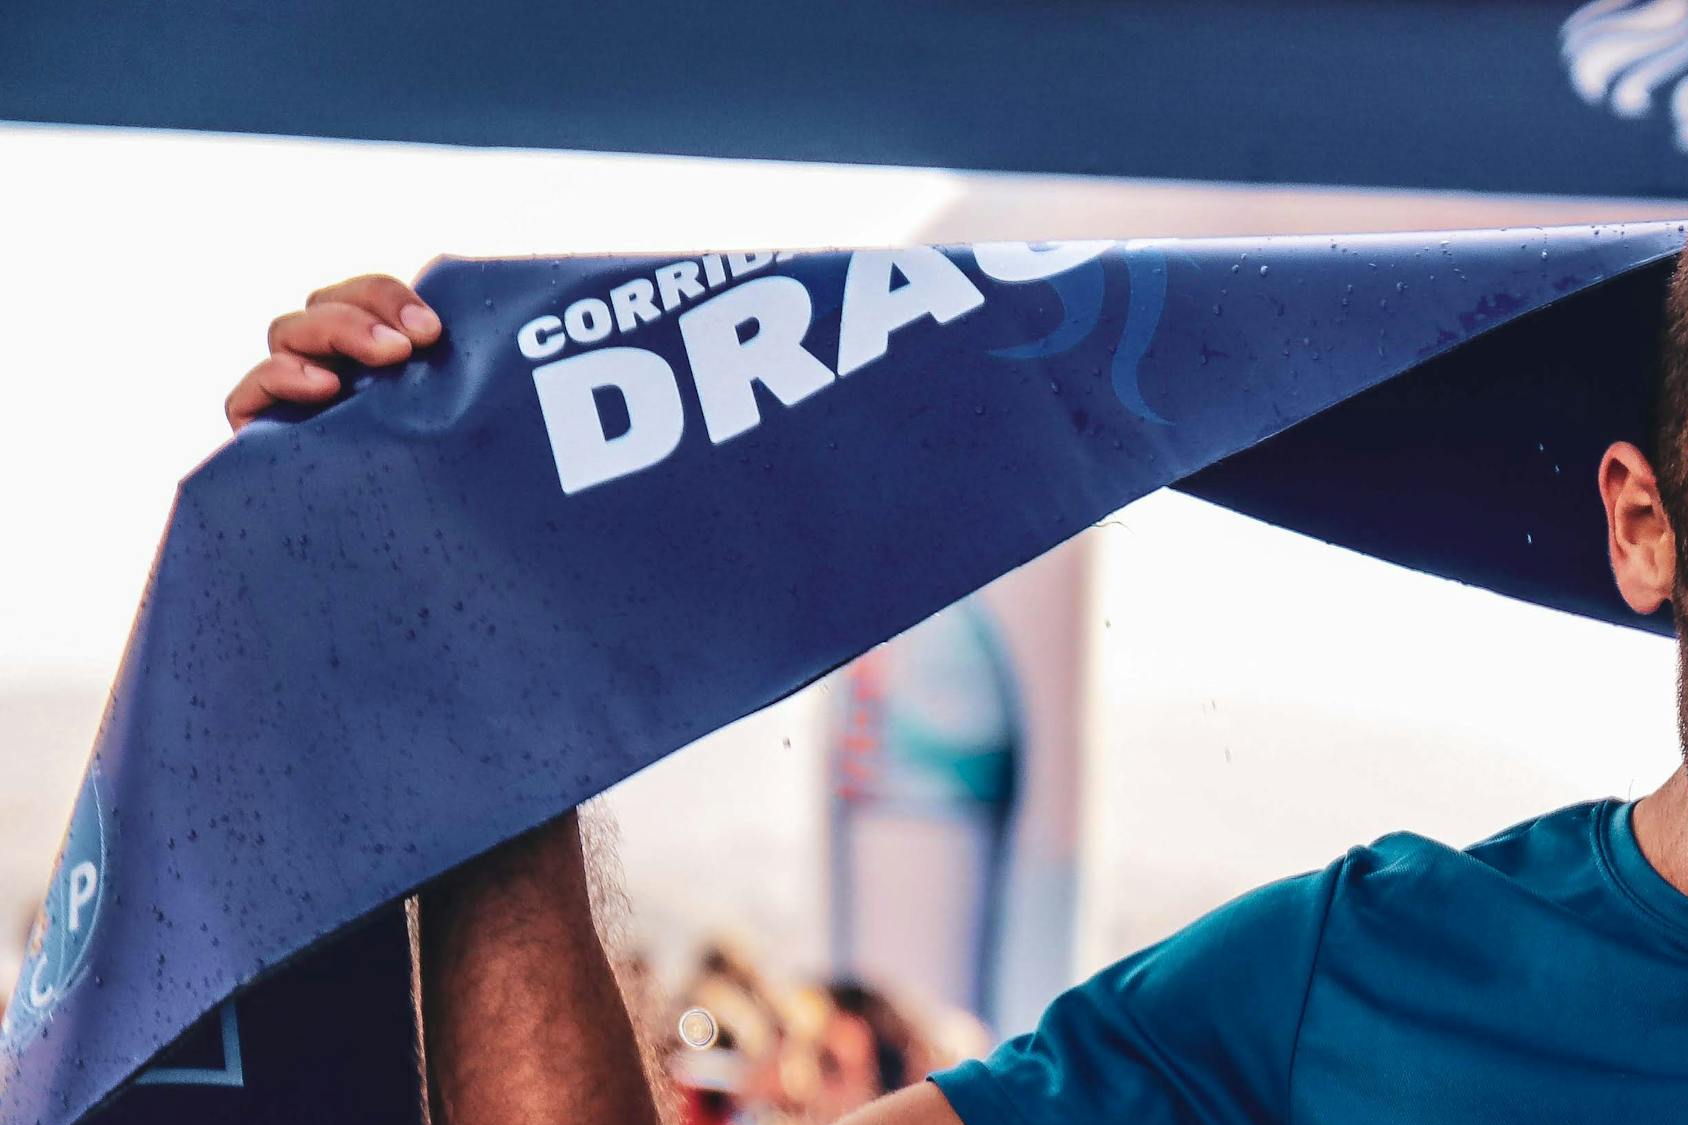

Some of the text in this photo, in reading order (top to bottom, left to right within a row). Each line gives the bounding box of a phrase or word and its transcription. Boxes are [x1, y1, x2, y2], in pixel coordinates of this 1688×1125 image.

[516, 251, 797, 360] CORRID
[532, 240, 1145, 495] DRA
[68, 861, 97, 932] P
